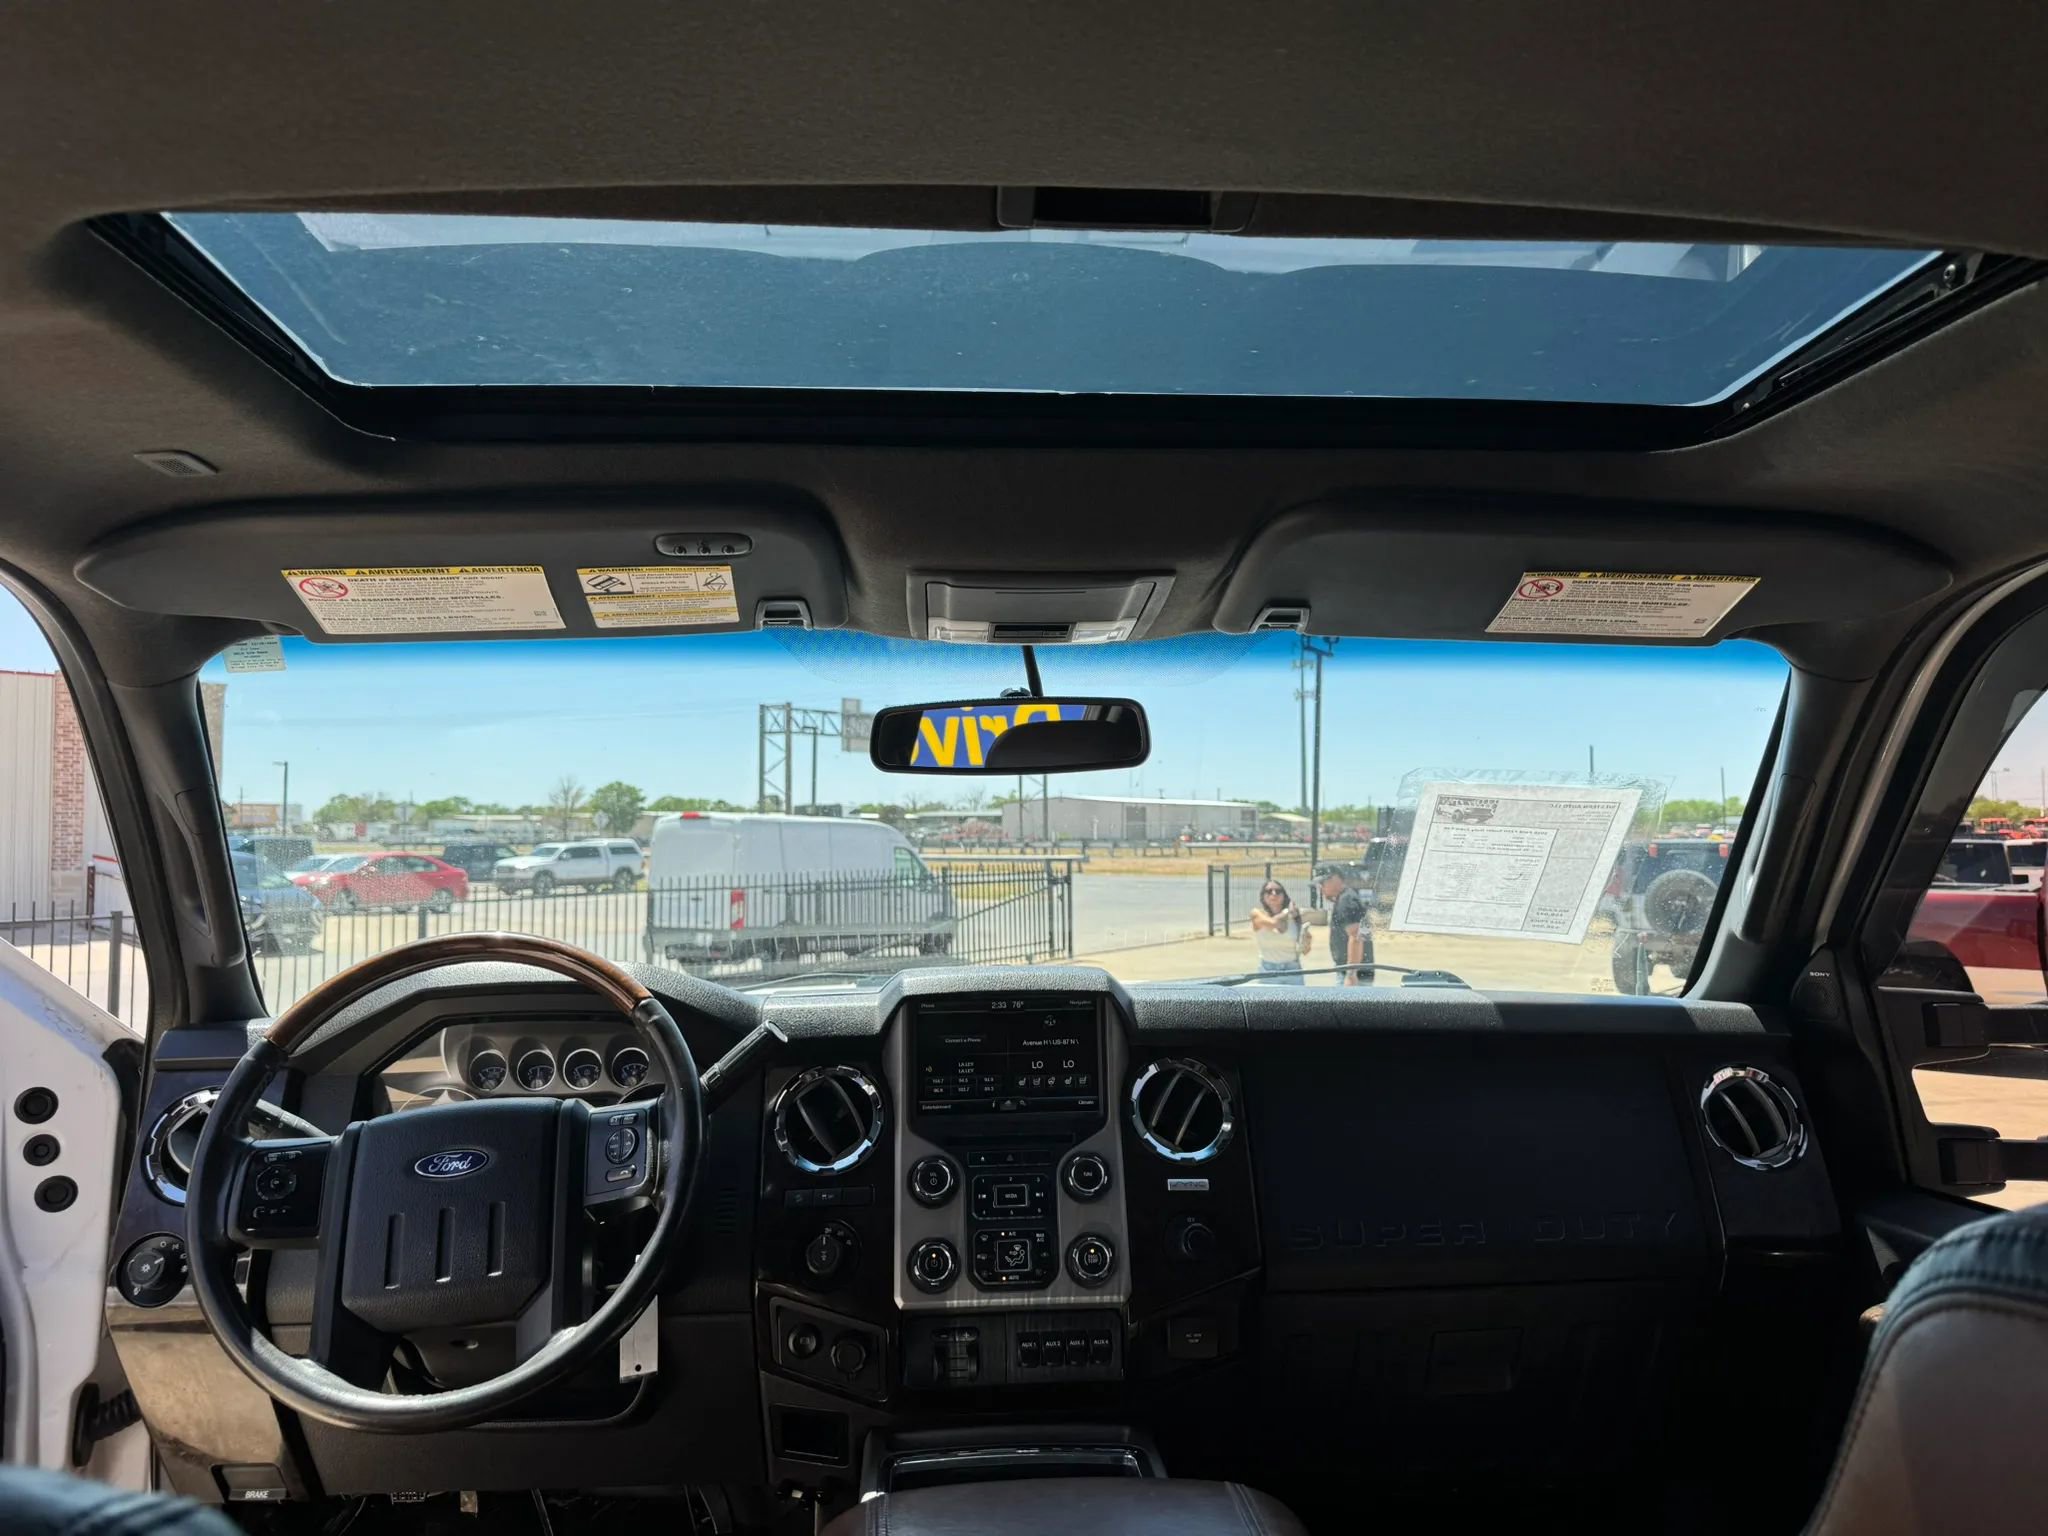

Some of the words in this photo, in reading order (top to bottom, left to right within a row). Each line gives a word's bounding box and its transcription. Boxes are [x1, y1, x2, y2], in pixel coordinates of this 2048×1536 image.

[471, 566, 541, 574] ADVERTENCIA
[991, 1001, 1007, 1009] 2:33
[1031, 1060, 1044, 1069] LO
[1062, 1059, 1075, 1068] LO
[428, 1153, 471, 1172] Ford
[1288, 1219, 1487, 1250] SUPER
[1532, 1211, 1678, 1242] DUTY
[245, 1490, 270, 1499] BRAKE
